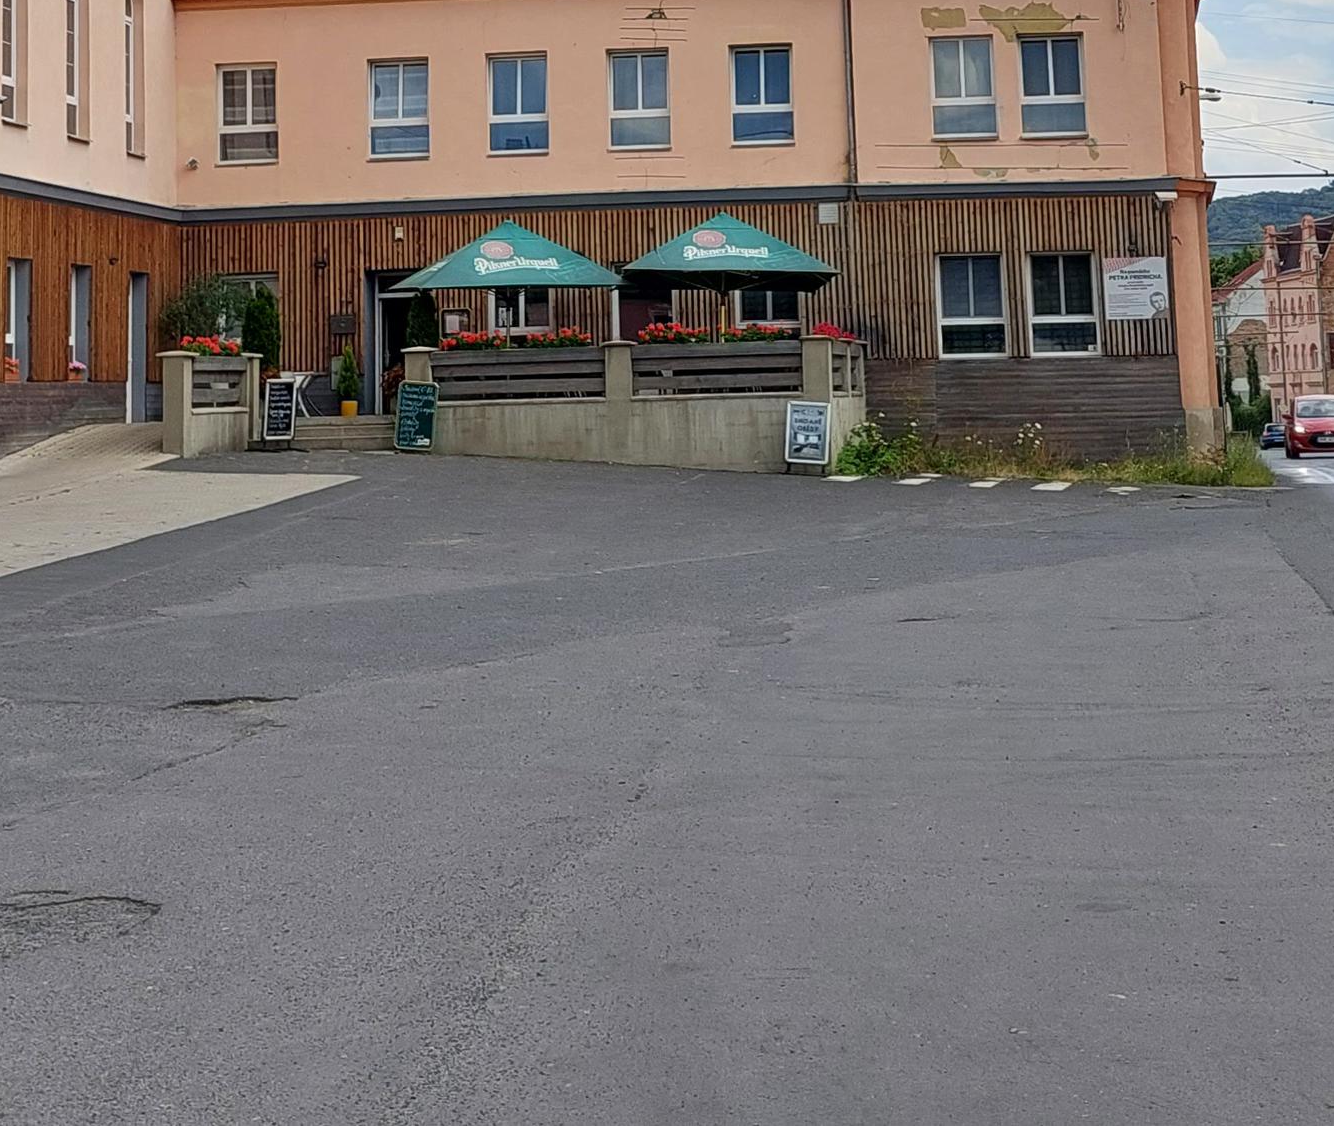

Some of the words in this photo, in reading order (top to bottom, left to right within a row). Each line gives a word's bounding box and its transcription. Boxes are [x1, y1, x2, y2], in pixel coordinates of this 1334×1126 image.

[683, 245, 726, 261] Pilsner
[724, 244, 769, 258] Urquell
[474, 257, 516, 275] Pilsner
[513, 256, 560, 270] Urquell
